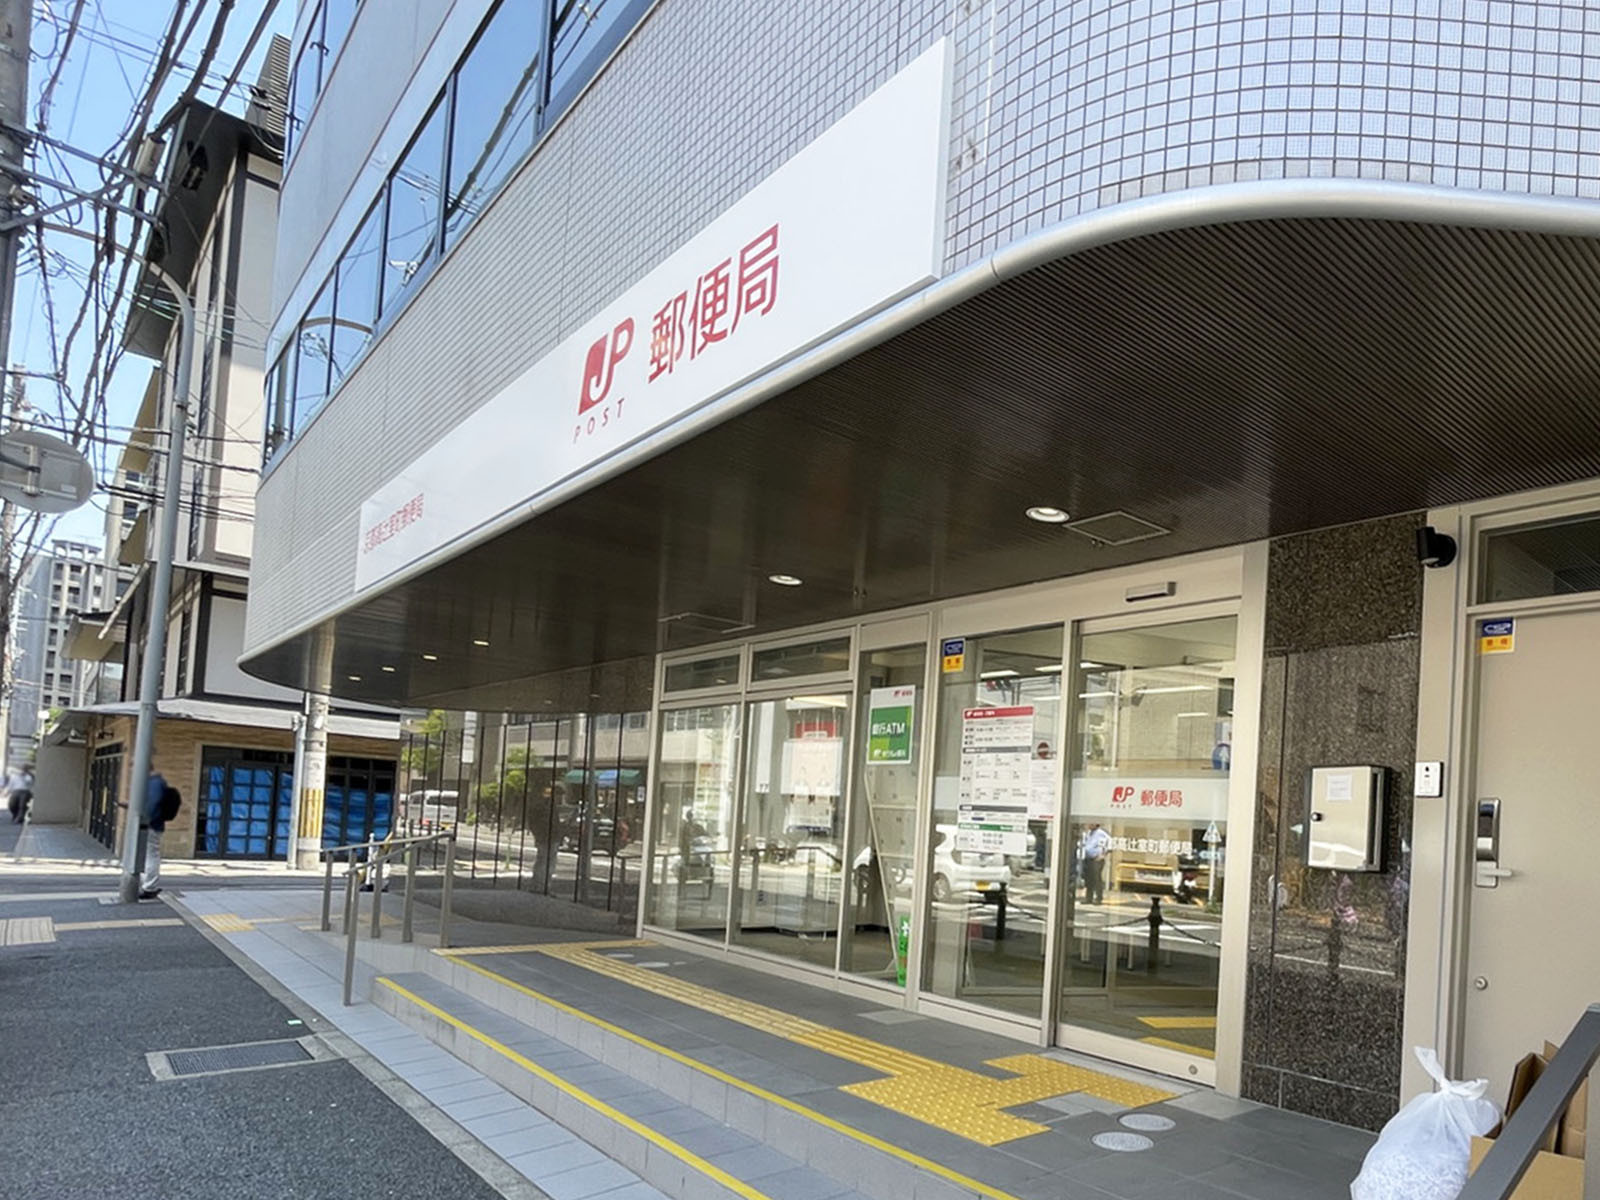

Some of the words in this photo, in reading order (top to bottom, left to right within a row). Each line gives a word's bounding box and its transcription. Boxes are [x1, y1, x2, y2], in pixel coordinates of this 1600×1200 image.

[648, 223, 780, 385] 郵便局
[573, 397, 625, 444] POST
[1140, 789, 1183, 808] 郵便局
